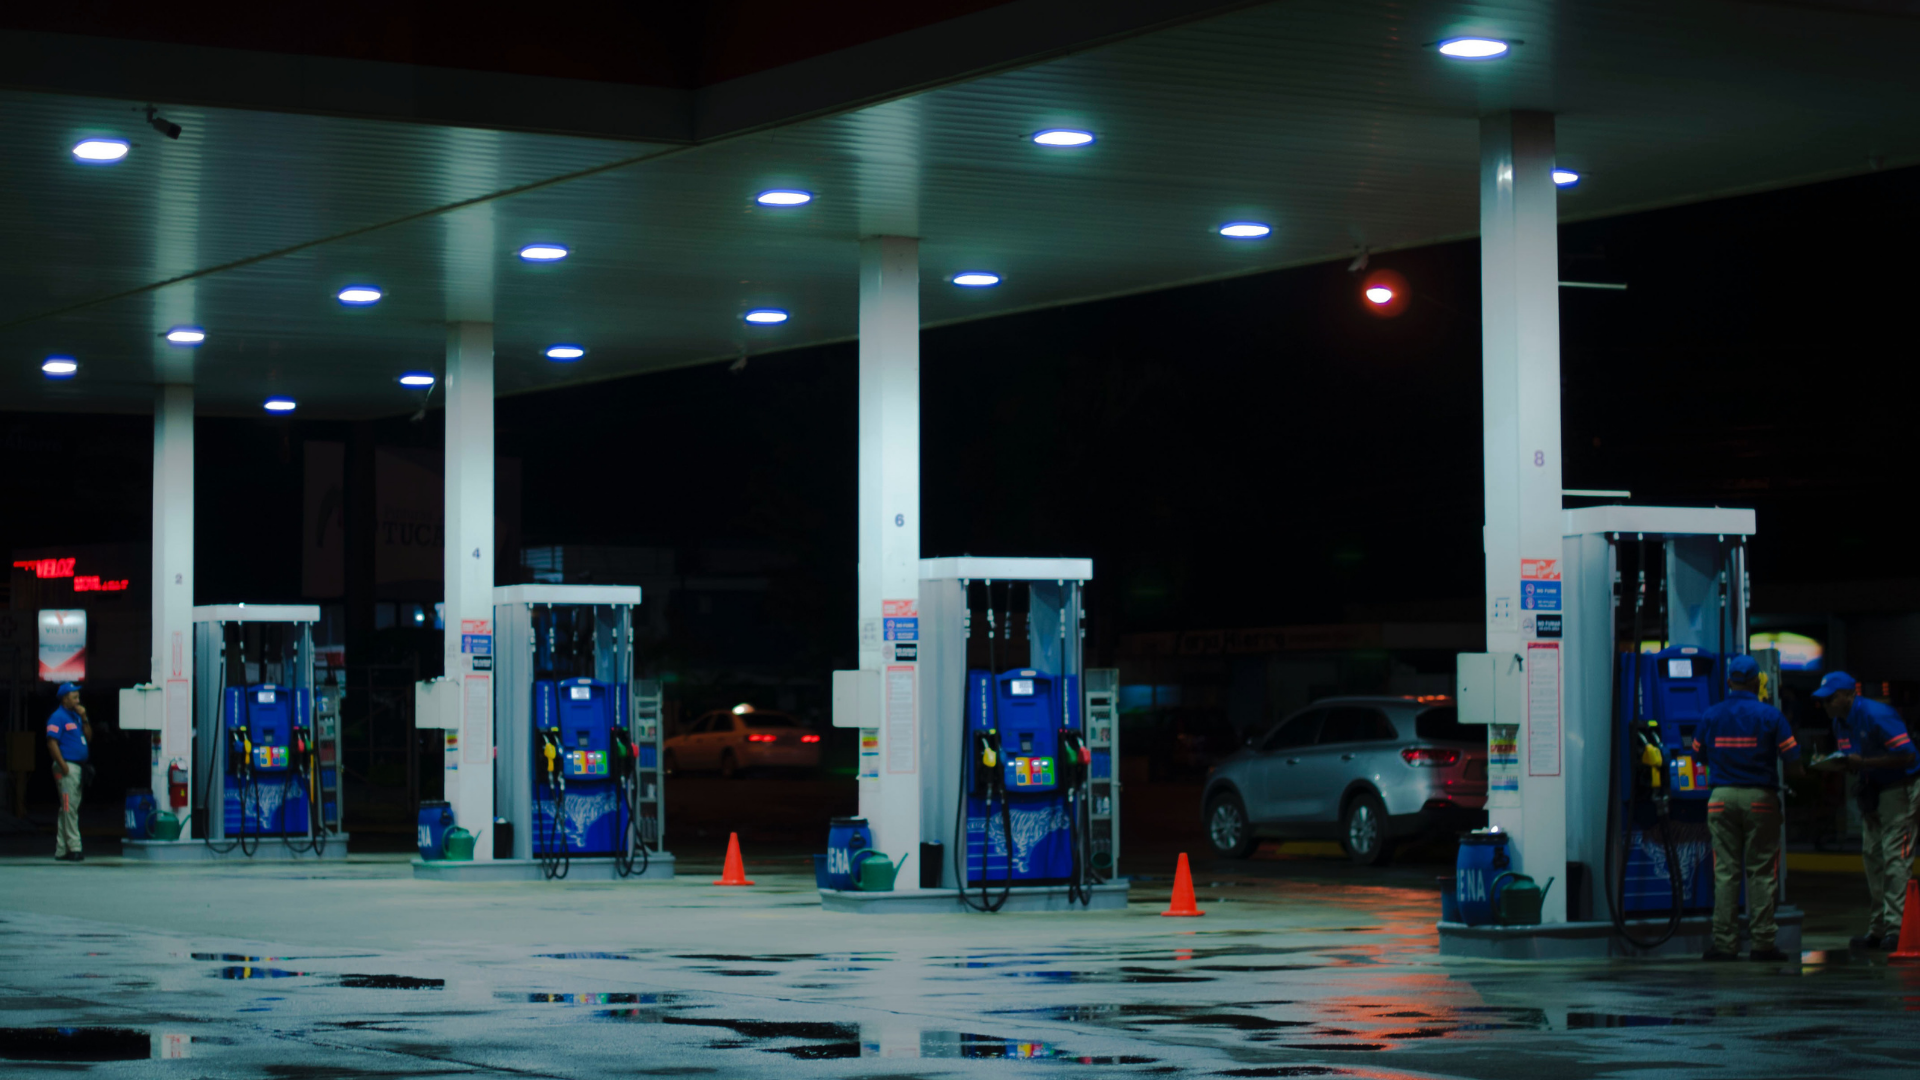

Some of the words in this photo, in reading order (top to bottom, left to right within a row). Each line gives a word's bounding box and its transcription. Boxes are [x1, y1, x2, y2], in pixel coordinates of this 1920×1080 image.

[1534, 450, 1545, 467] 8
[894, 513, 905, 527] 6
[472, 547, 481, 559] 4
[175, 573, 183, 585] 2
